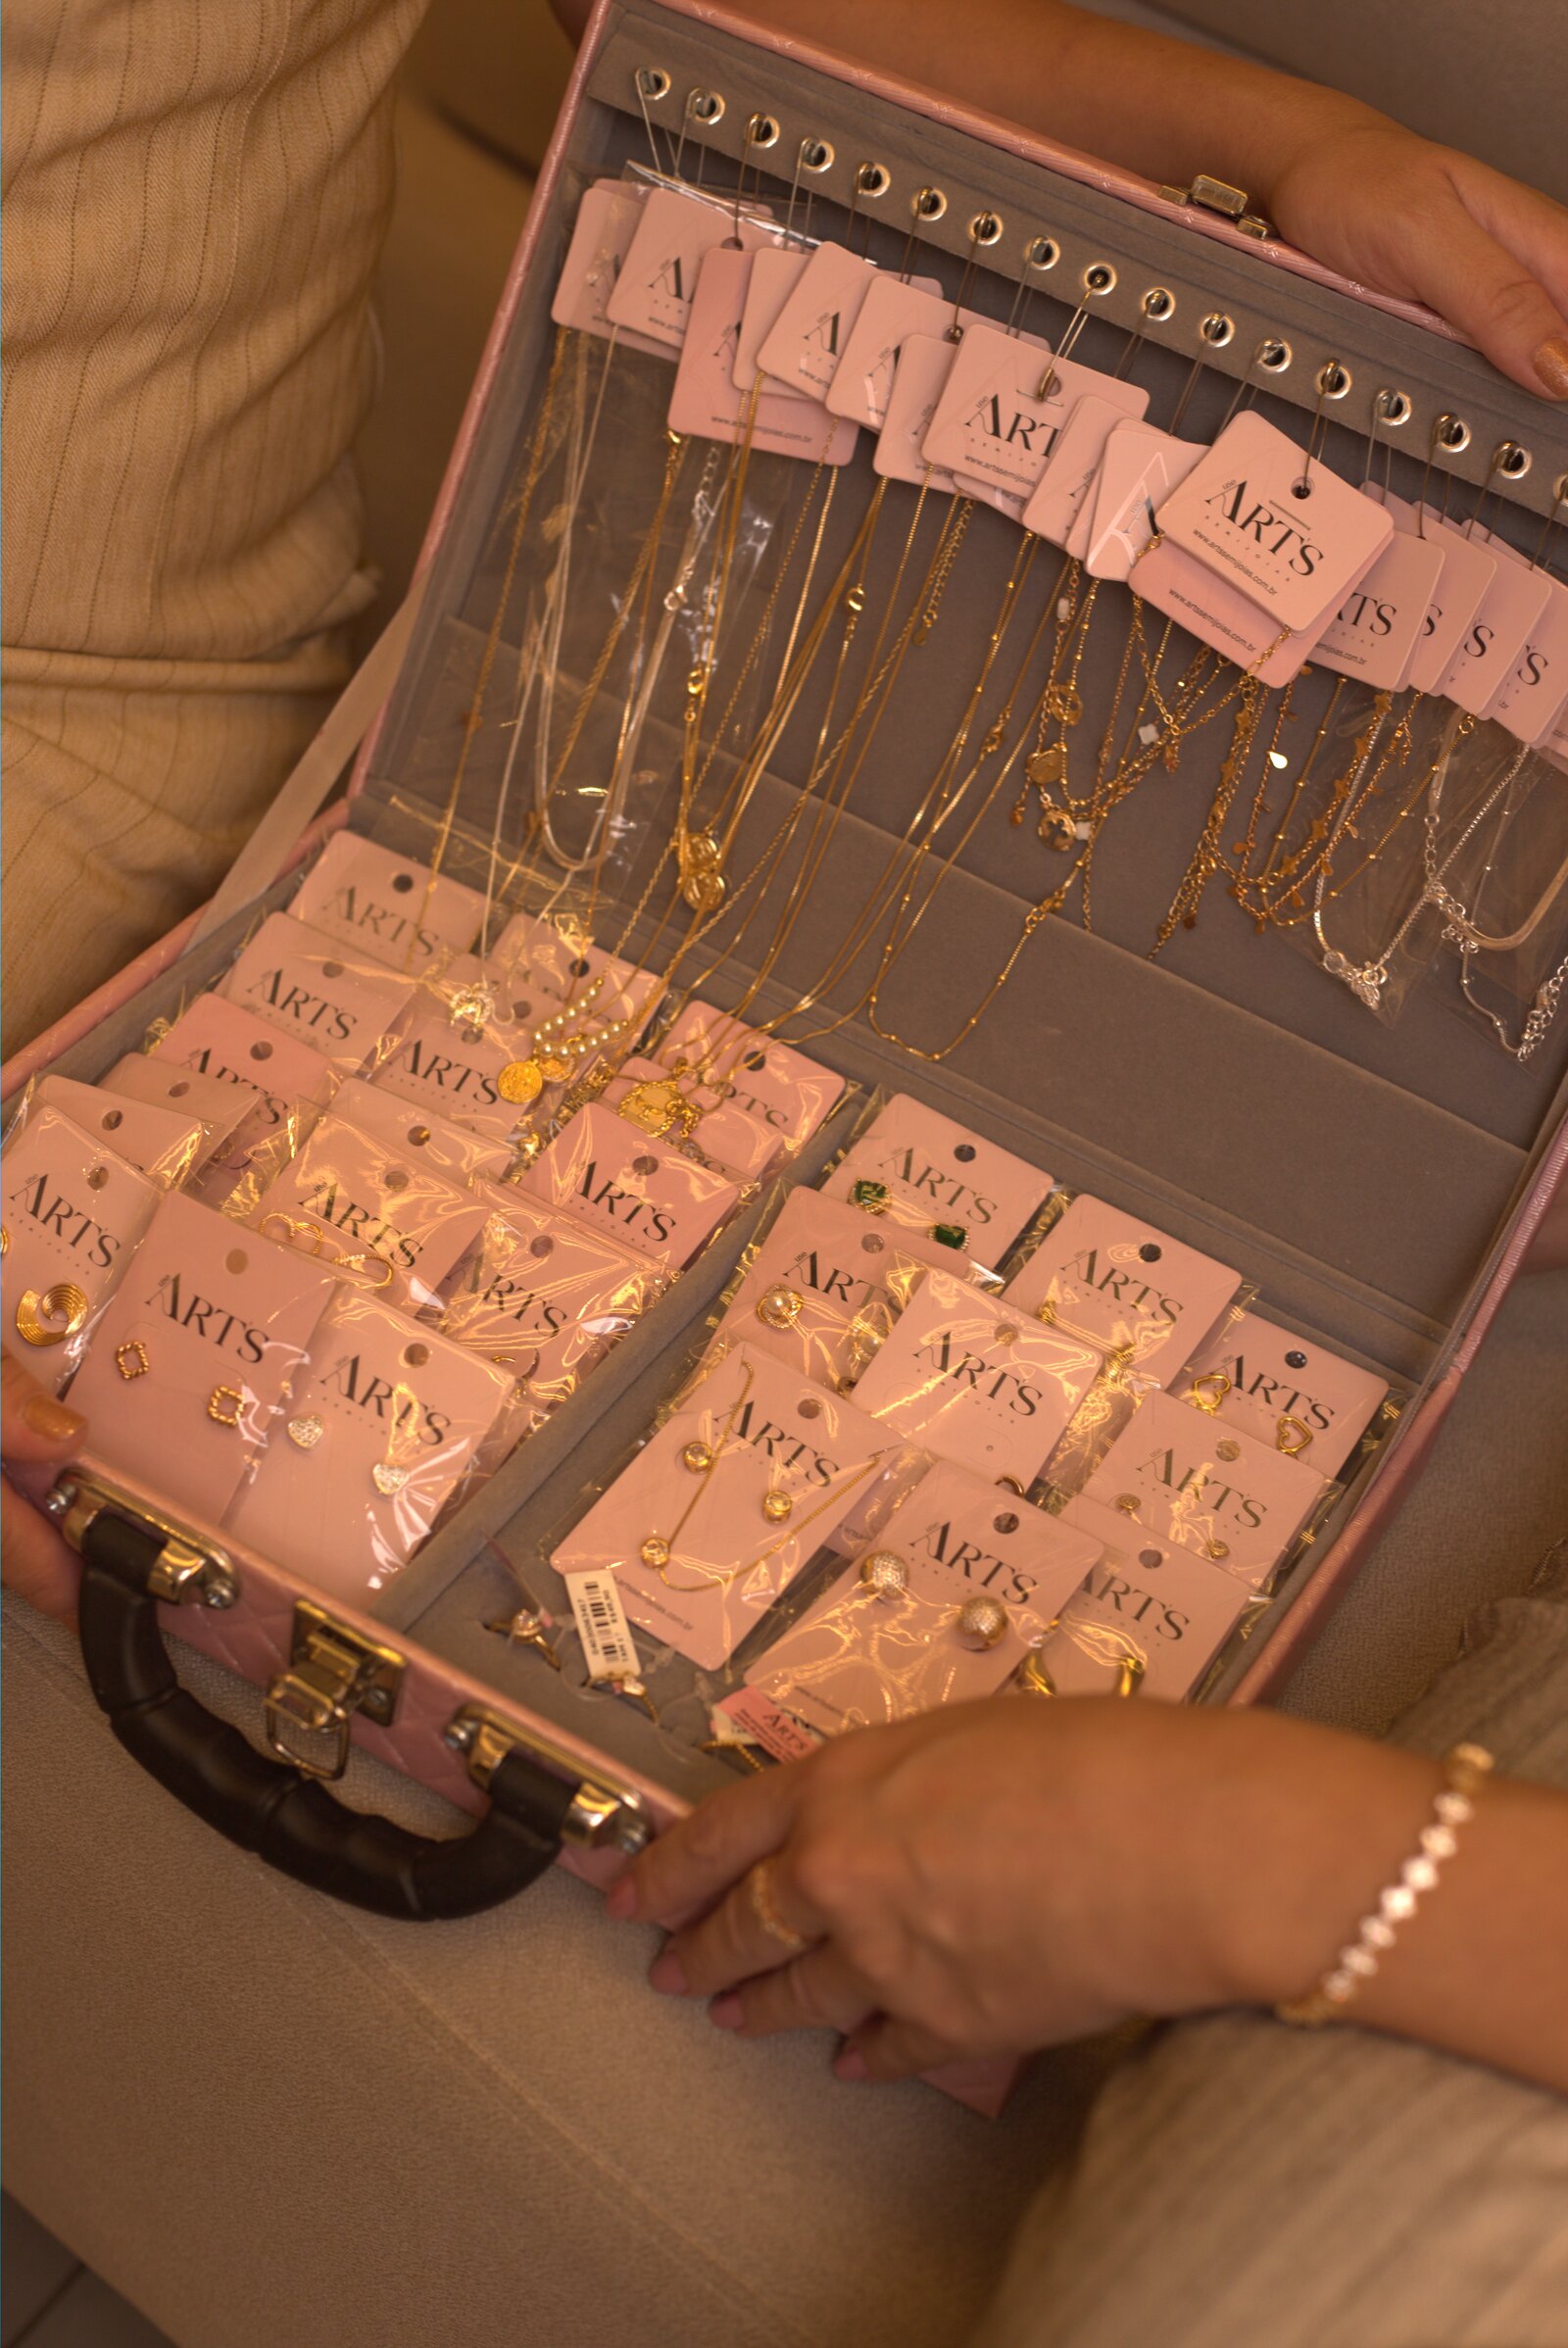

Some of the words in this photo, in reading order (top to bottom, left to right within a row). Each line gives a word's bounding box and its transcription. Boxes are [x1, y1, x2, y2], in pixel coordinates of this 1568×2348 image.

[963, 393, 1061, 459] ART
[1204, 480, 1324, 576] ARTS
[322, 886, 439, 956] ARTS
[247, 968, 358, 1040] ARTS
[388, 1039, 498, 1105] ARTS
[9, 1173, 122, 1268] ARTS
[297, 1182, 423, 1269] ARTS
[878, 1148, 998, 1225] ARTS
[145, 1273, 270, 1364] ARTS
[1059, 1248, 1184, 1325] ARTS
[319, 1353, 451, 1445] ARTS
[913, 1331, 1043, 1416] ARTS
[1209, 1355, 1336, 1430] ARTS
[712, 1399, 841, 1488] ARTS
[1136, 1447, 1268, 1529] ARTS
[908, 1521, 1040, 1605] ARTS
